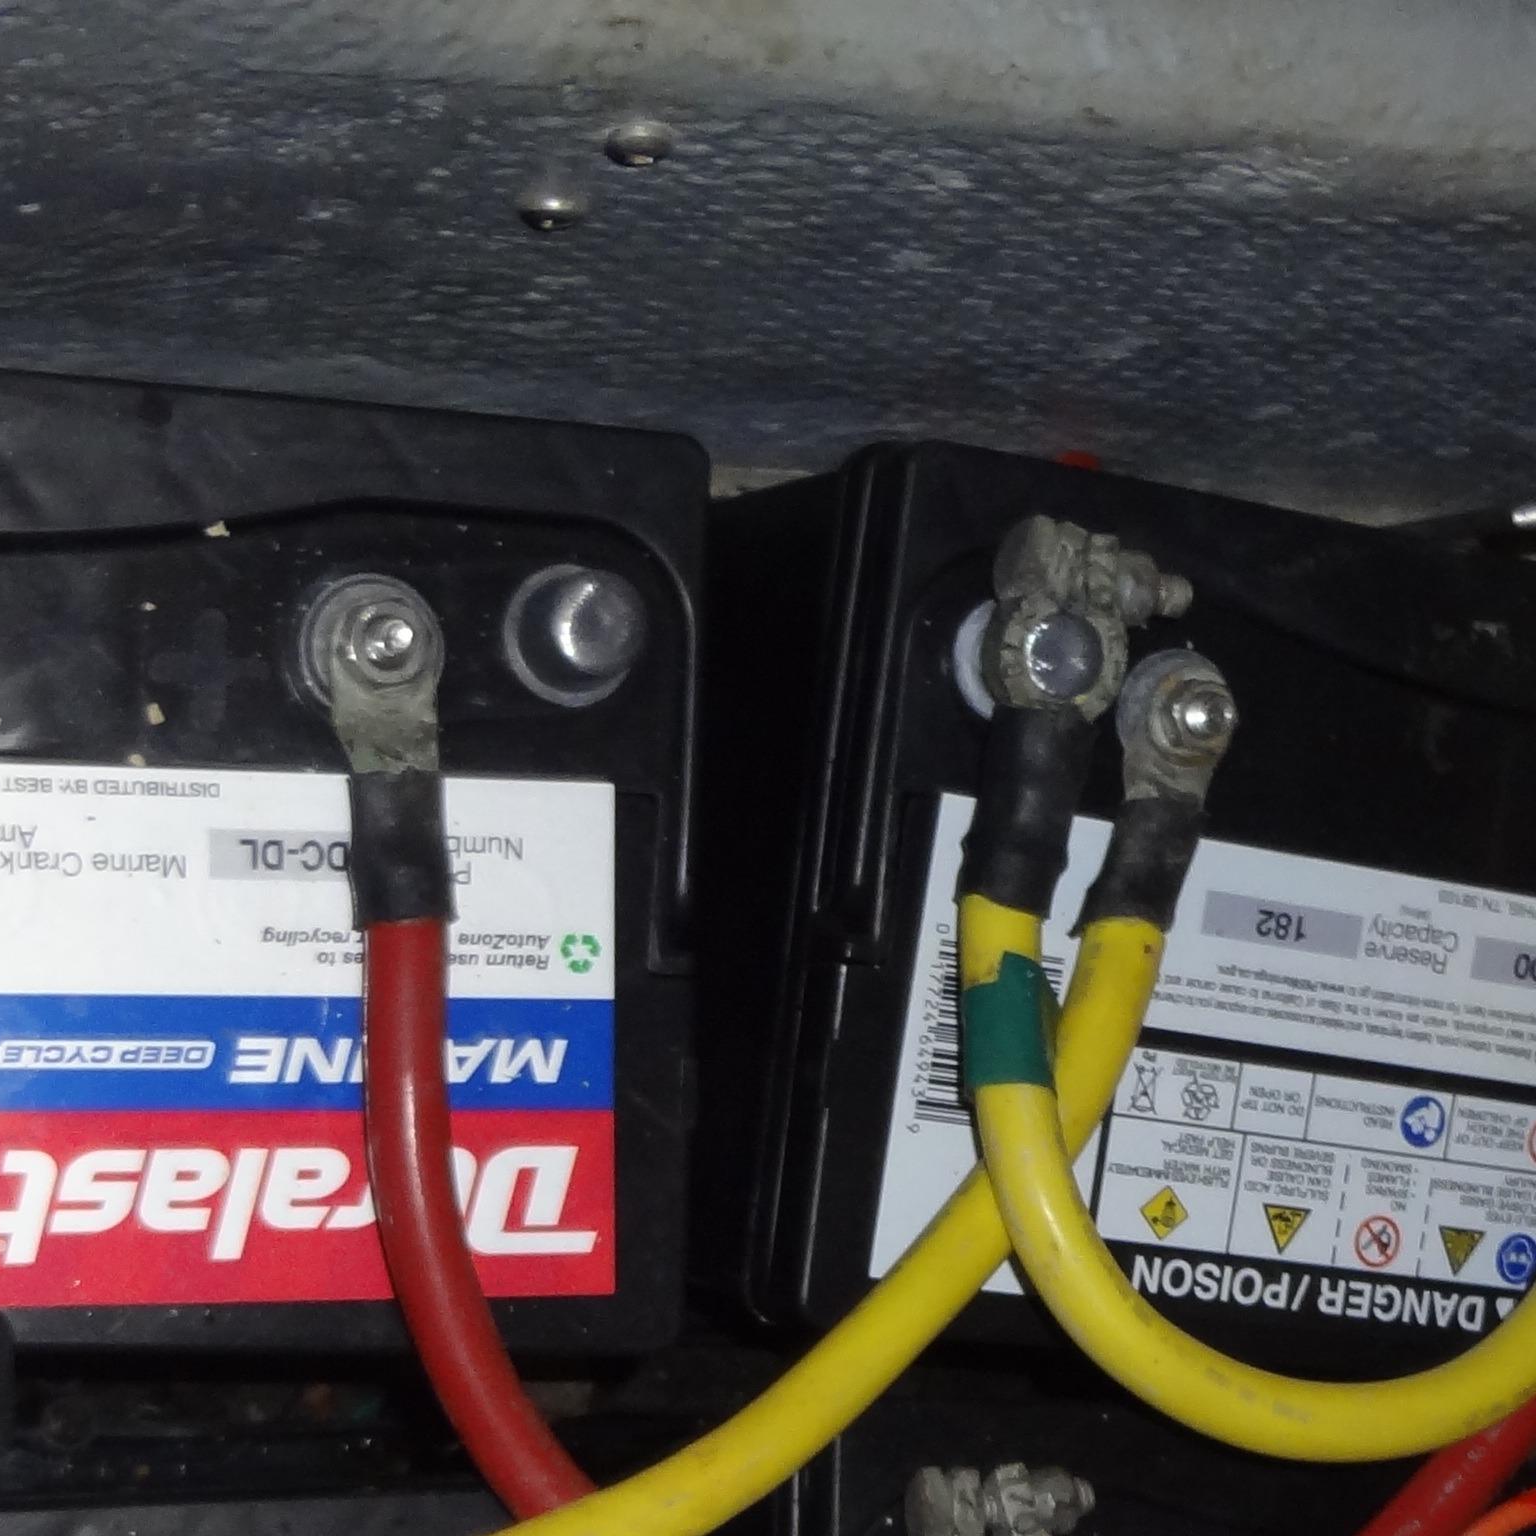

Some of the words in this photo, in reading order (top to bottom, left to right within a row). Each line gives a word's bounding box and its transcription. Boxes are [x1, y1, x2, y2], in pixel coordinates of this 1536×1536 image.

[4, 776, 53, 794] BEST
[93, 779, 220, 797] DISTRIBUTED
[239, 837, 350, 872] DC-DL
[445, 835, 524, 861] Numb
[92, 851, 186, 879] Marine
[261, 926, 351, 948] recycling
[1252, 906, 1309, 944] 182
[1365, 911, 1460, 954] Capacity
[458, 932, 551, 950] AutoZone
[486, 952, 551, 970] Return
[1361, 939, 1448, 975] Reserve
[0, 1045, 115, 1065] CYCLE
[120, 1045, 207, 1065] DEEP
[229, 1037, 568, 1084] MANE
[1314, 1275, 1487, 1332] DANGER
